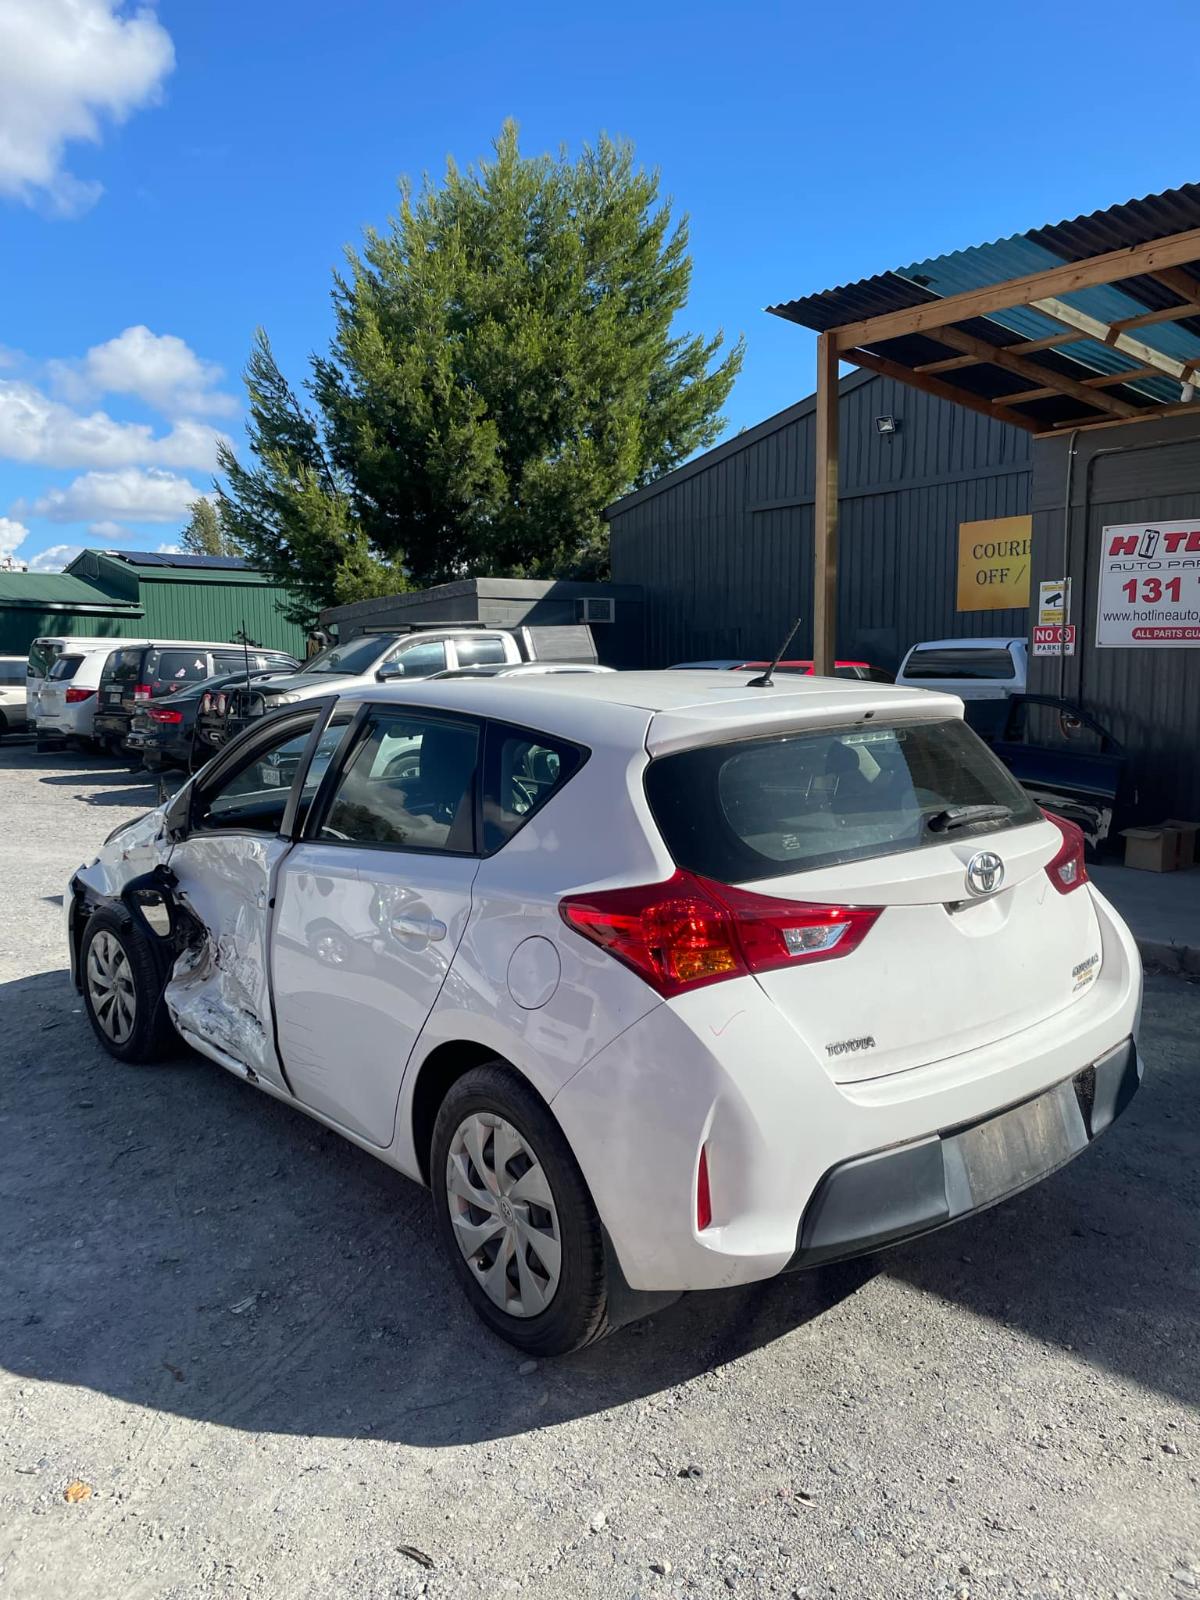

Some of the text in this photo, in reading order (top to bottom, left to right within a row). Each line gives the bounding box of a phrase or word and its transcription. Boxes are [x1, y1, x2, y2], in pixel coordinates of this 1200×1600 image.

[973, 539, 1032, 560] COURI
[1110, 561, 1162, 571] AUTO
[976, 564, 1026, 585] OFF /
[1122, 577, 1181, 604] 131
[1103, 609, 1200, 624] www.hotlineauto
[1036, 630, 1054, 641] NO
[1134, 629, 1200, 638] ALL PARTS GU
